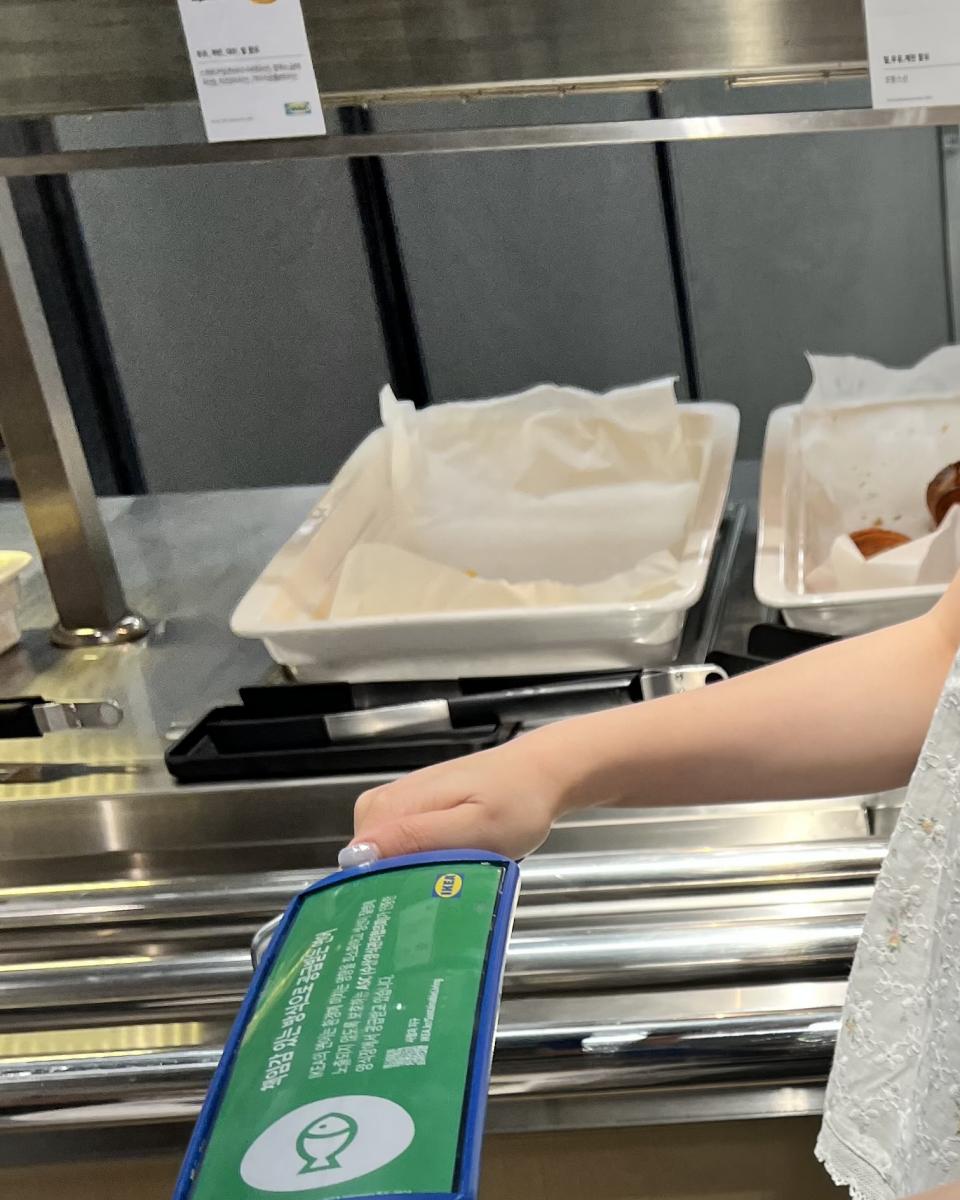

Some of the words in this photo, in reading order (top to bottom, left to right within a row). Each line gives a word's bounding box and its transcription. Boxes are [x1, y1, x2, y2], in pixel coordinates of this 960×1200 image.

[442, 874, 457, 896] IKEA
[282, 982, 313, 1027] 방식으로
[273, 1025, 302, 1051] 있는
[261, 1052, 293, 1091] 책임감
